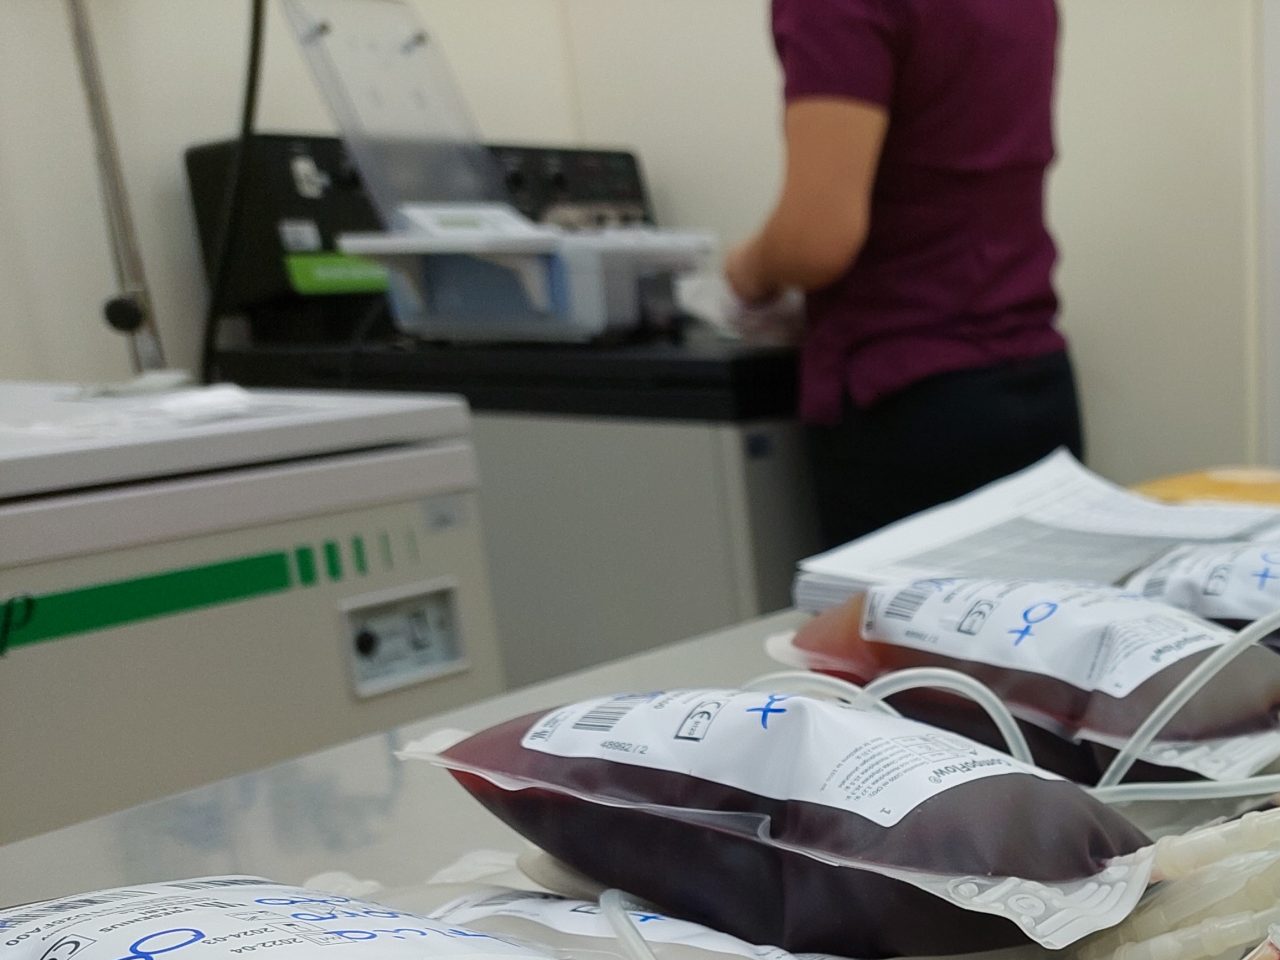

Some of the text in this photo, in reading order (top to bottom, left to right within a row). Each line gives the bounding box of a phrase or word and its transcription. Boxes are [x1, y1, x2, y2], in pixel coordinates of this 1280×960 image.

[1007, 601, 1059, 647] O+
[98, 907, 193, 933] FRESENIUS
[201, 926, 274, 946] 2024-03
[230, 937, 304, 954] 2022-04
